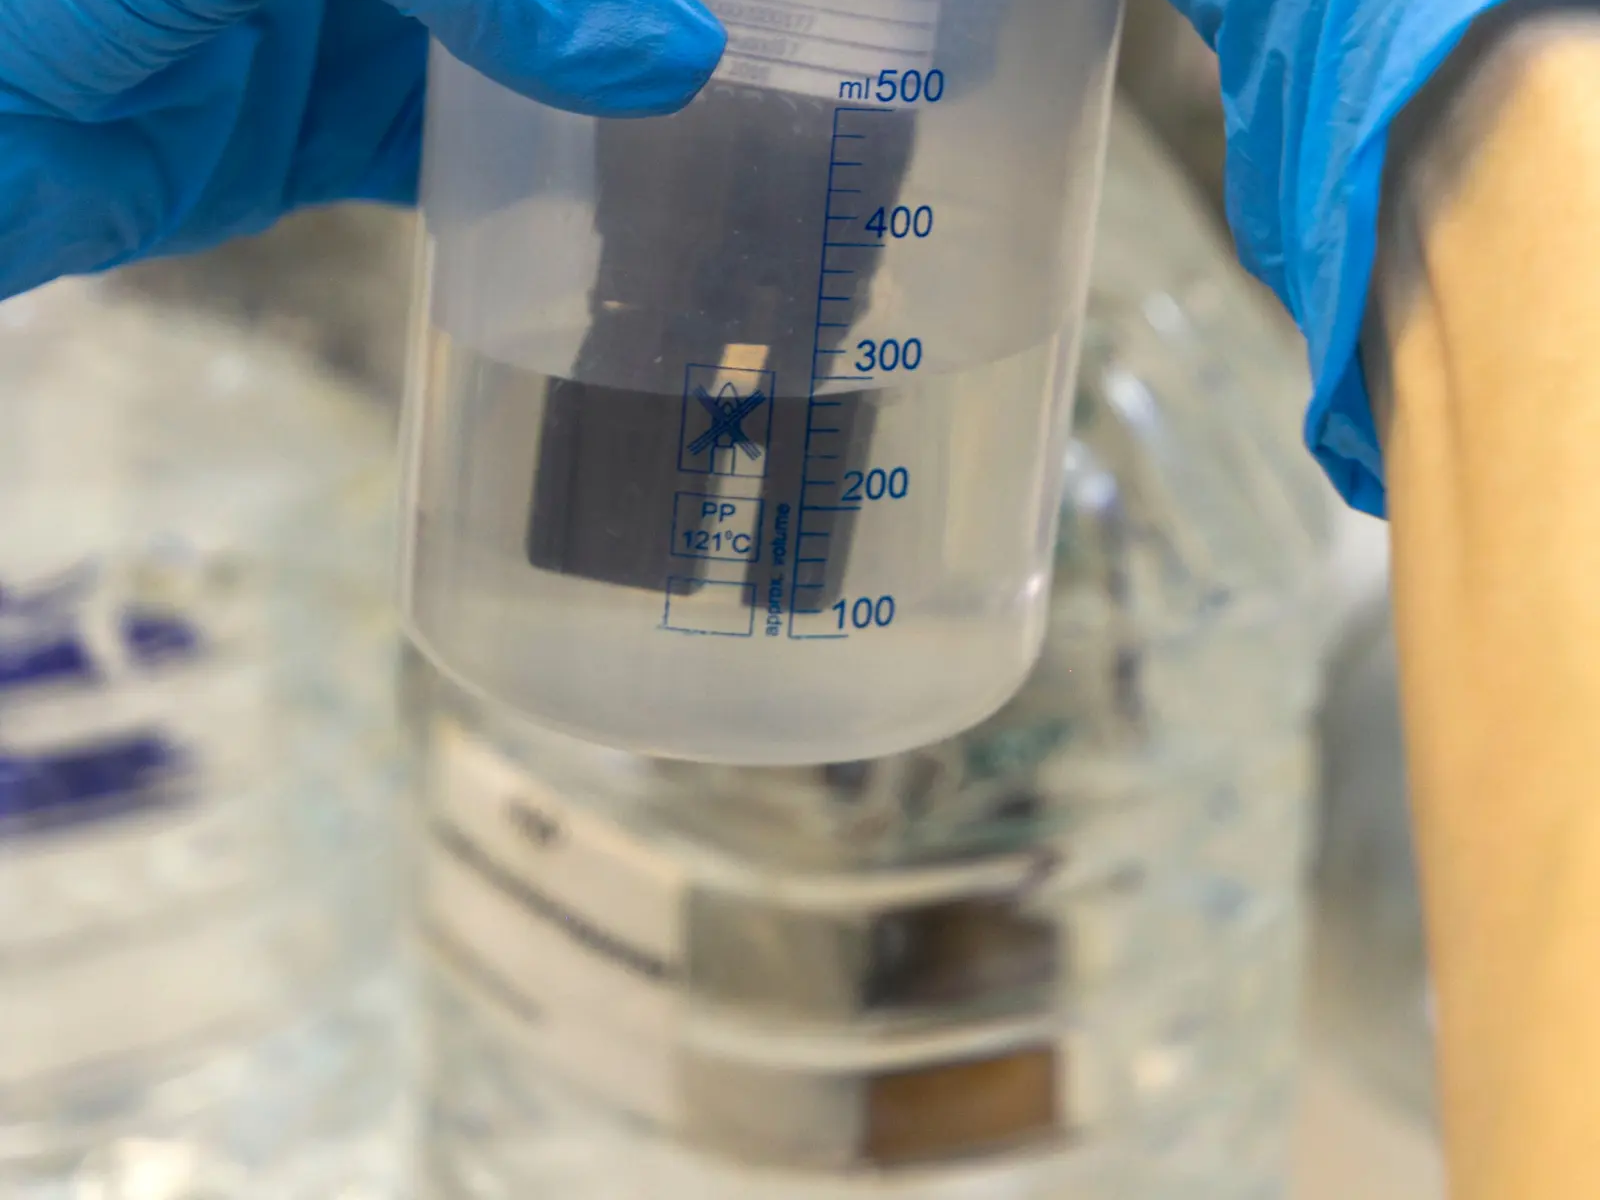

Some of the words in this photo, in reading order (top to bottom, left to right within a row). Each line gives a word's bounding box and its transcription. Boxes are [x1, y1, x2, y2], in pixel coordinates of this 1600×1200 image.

[838, 77, 870, 99] ml
[875, 68, 945, 102] 500
[864, 205, 934, 239] 400
[854, 337, 923, 372] 300
[841, 467, 909, 502] 200
[701, 502, 736, 522] PP
[771, 503, 791, 566] volume
[832, 595, 896, 630] 100
